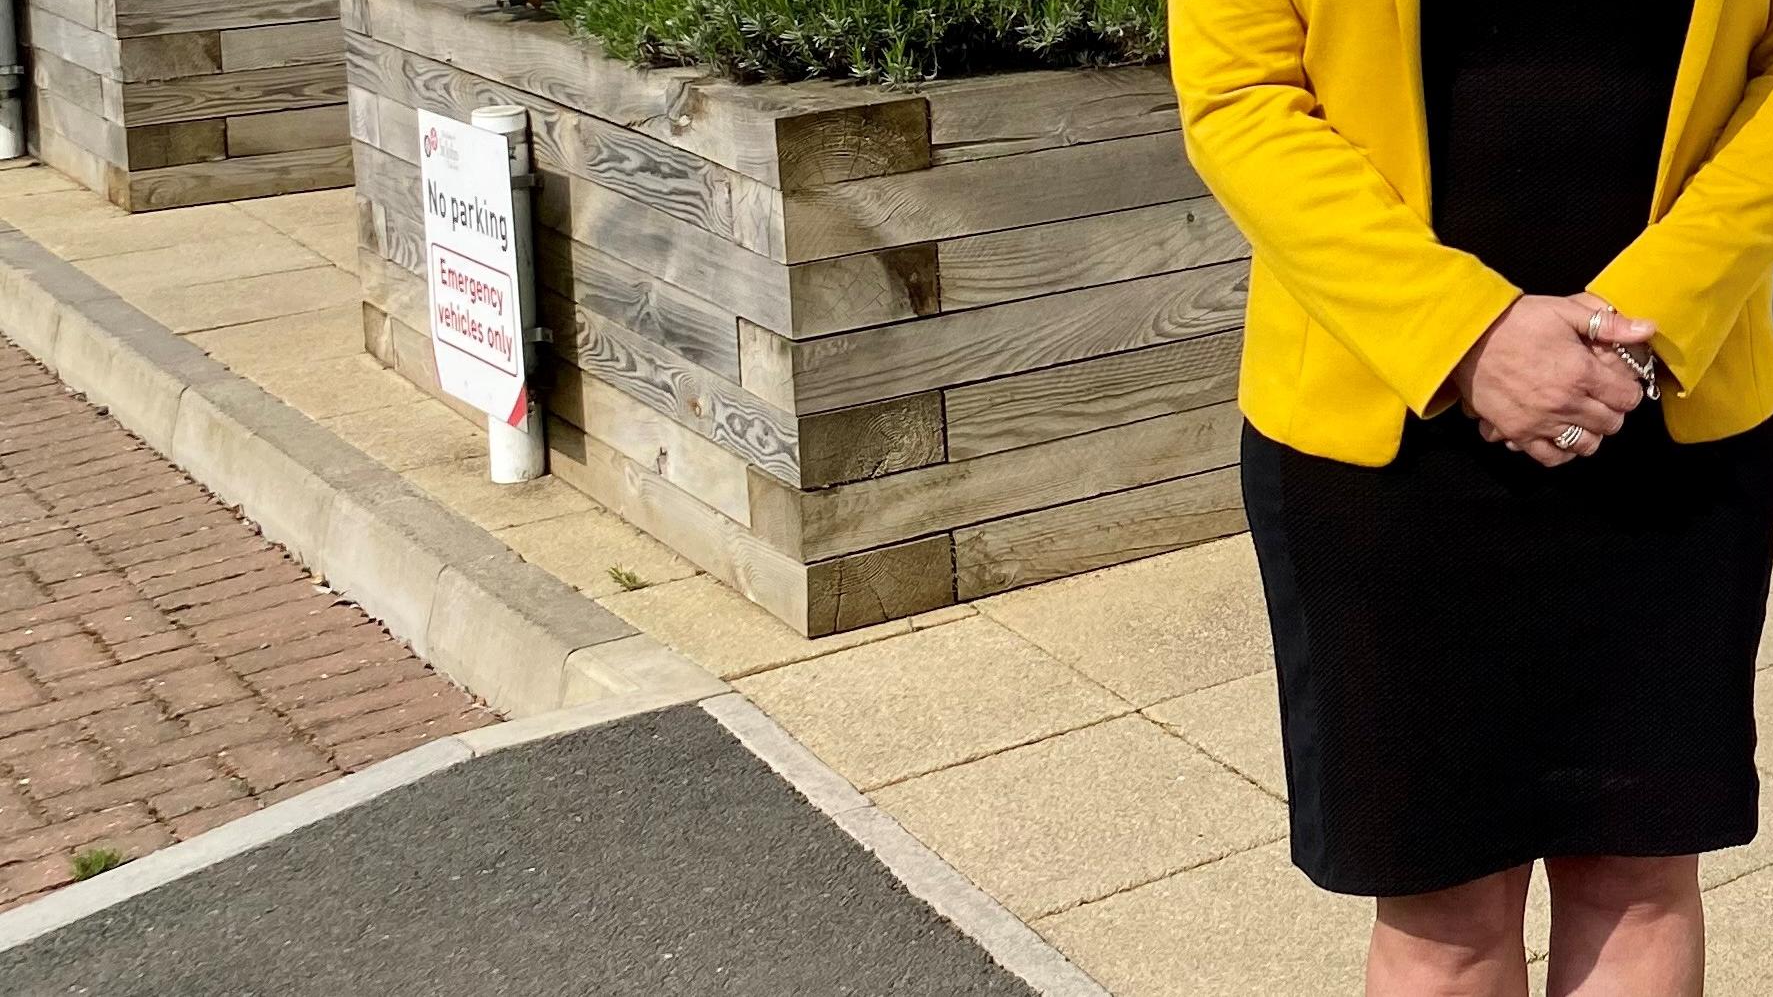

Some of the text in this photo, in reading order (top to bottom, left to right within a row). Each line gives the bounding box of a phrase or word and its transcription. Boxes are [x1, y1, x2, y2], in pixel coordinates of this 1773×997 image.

[427, 177, 509, 253] No parking
[439, 258, 504, 317] Emergency
[437, 301, 513, 363] vehicles only
